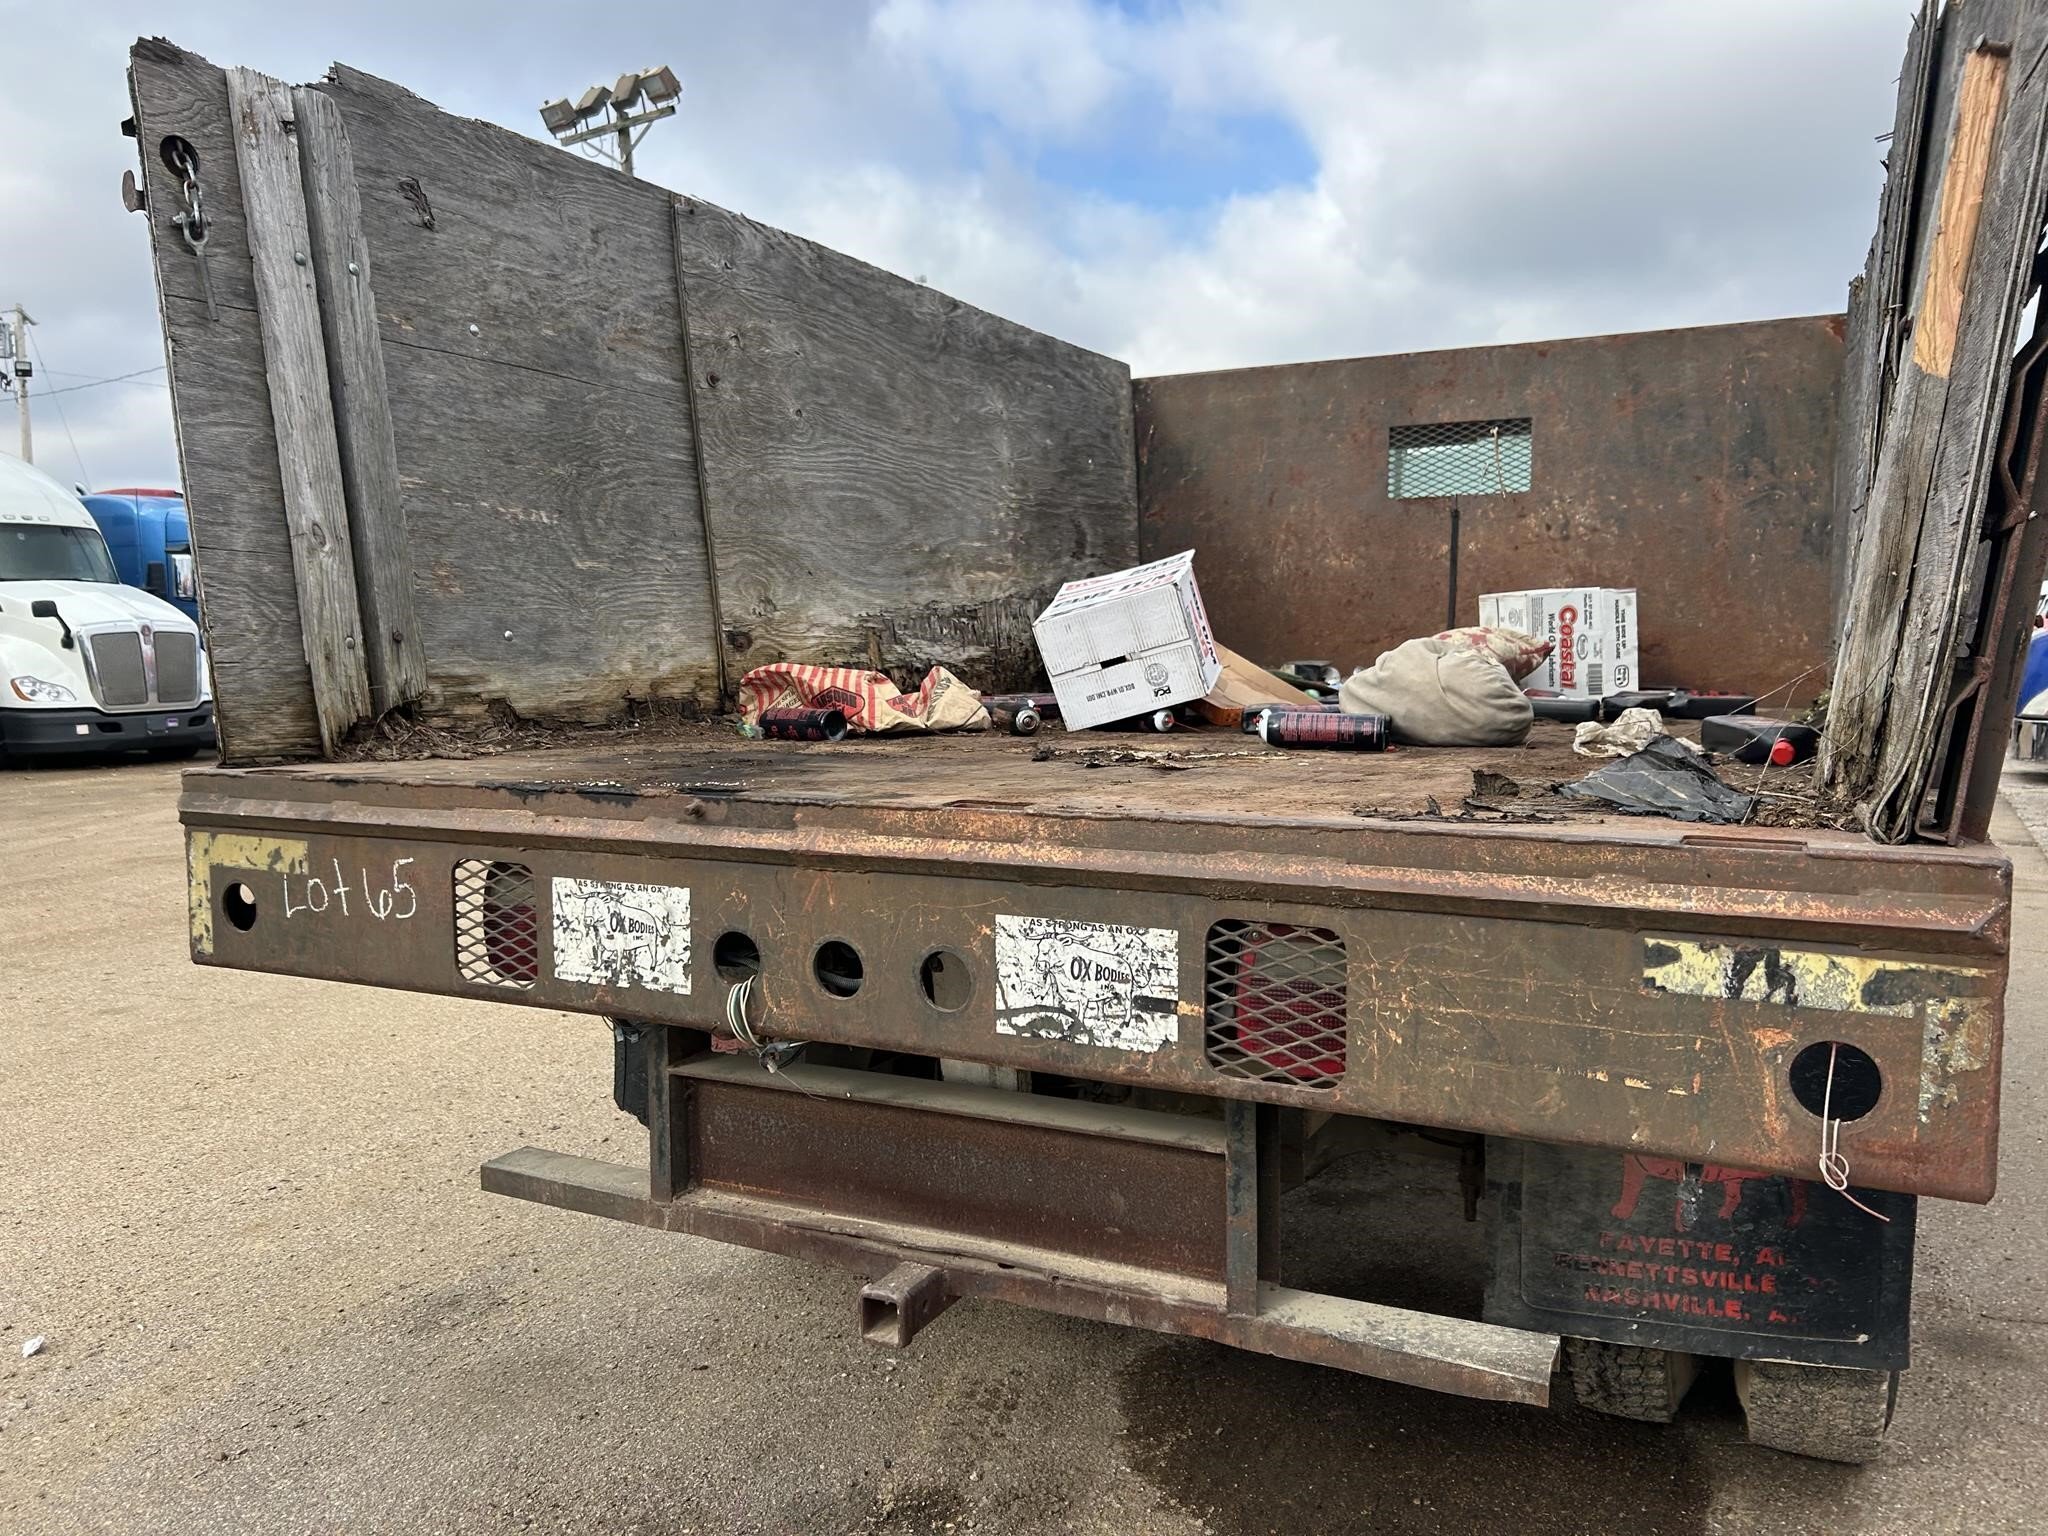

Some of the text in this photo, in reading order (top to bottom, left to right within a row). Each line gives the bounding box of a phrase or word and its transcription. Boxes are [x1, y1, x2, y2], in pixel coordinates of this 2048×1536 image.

[1548, 613, 1556, 634] World
[1558, 604, 1578, 690] Coastal
[1621, 640, 1627, 649] UP
[1153, 686, 1172, 698] PCA
[361, 857, 417, 921] 65
[624, 884, 635, 893] AS
[637, 884, 649, 893] AN
[609, 910, 655, 935] OX BODIES
[1046, 919, 1088, 931] STRONG
[1091, 923, 1105, 933] AS
[1107, 925, 1123, 935] AN
[1070, 955, 1131, 983] OX BODIES
[1600, 1231, 1740, 1267] FAYETTE,
